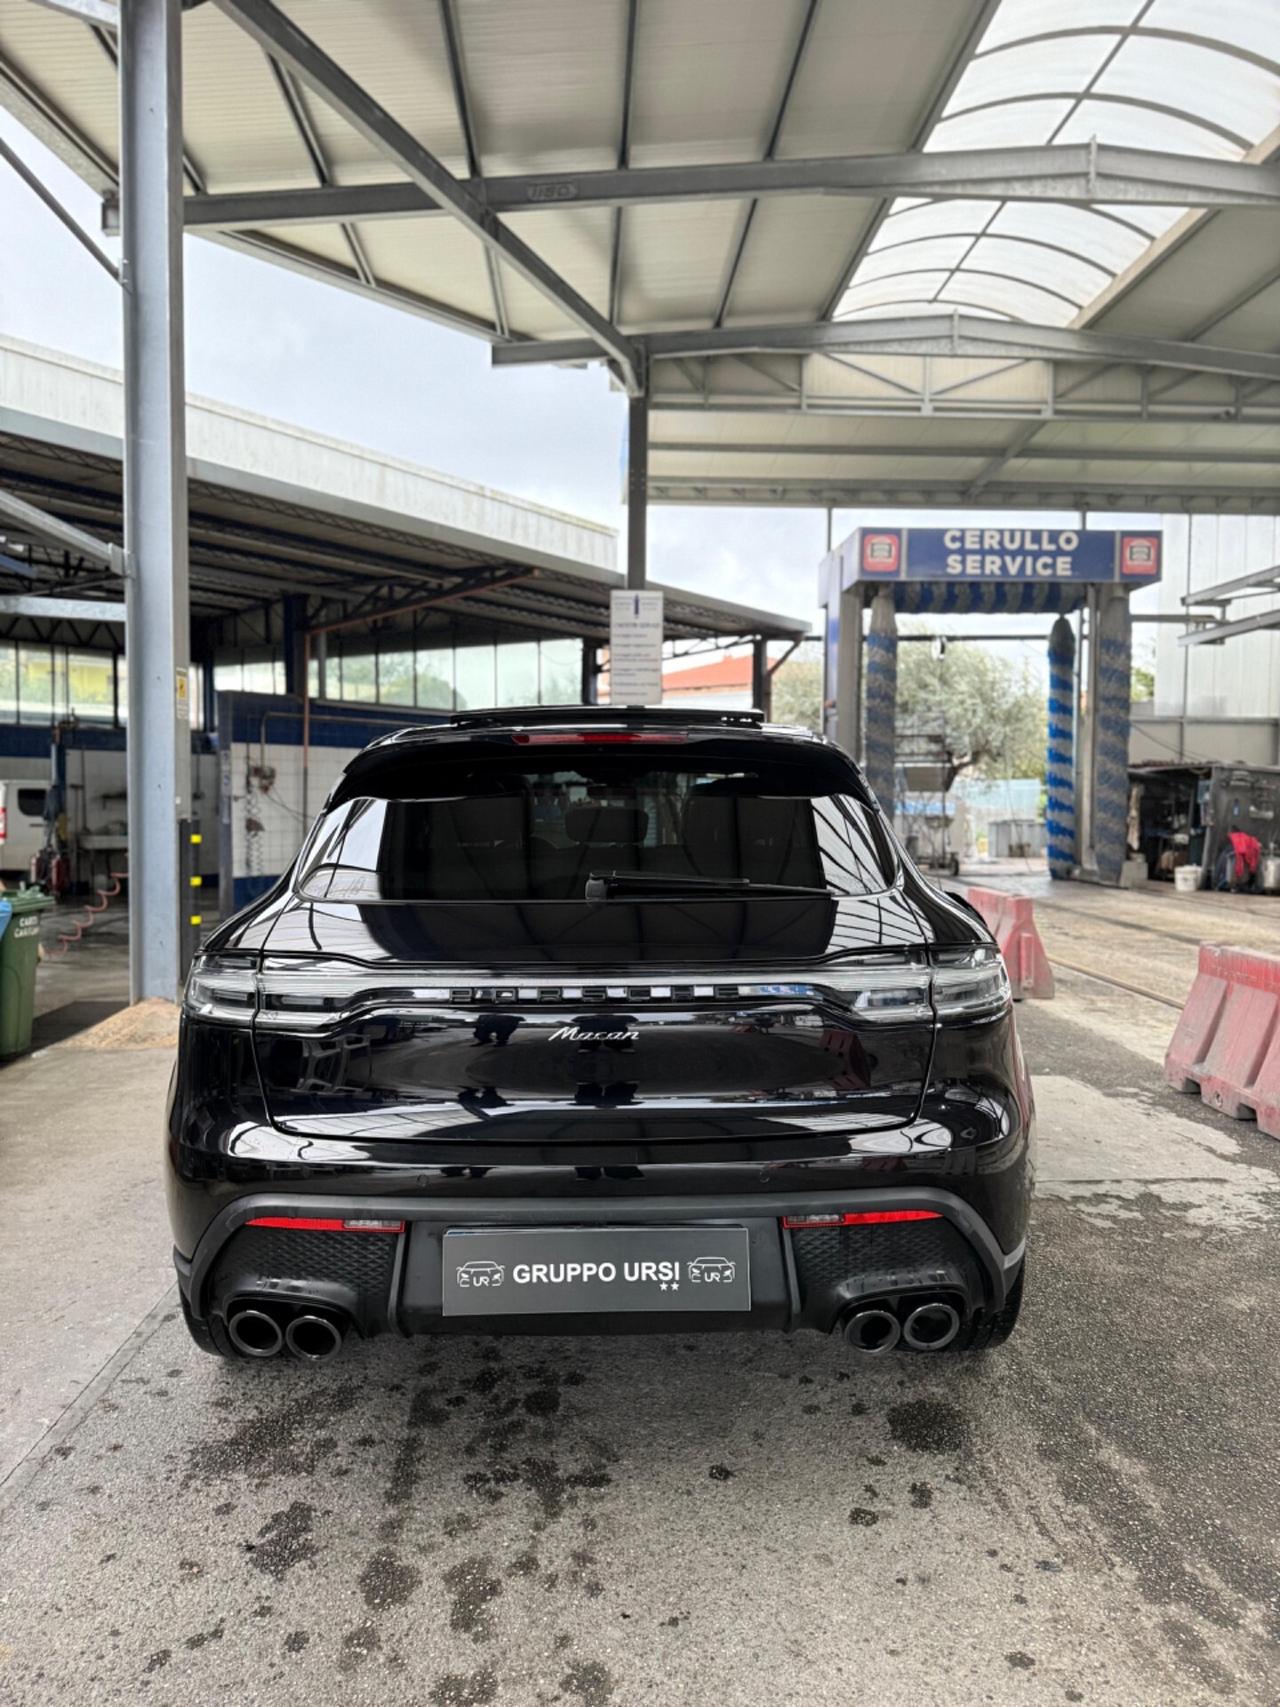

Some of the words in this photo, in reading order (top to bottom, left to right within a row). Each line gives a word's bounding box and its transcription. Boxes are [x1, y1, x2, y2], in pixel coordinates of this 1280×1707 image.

[944, 530, 1079, 551] CERULLO
[946, 554, 1073, 576] SERVICE
[548, 1026, 639, 1041] Macan
[512, 1263, 616, 1284] GRUPPO
[623, 1261, 680, 1281] URSI
